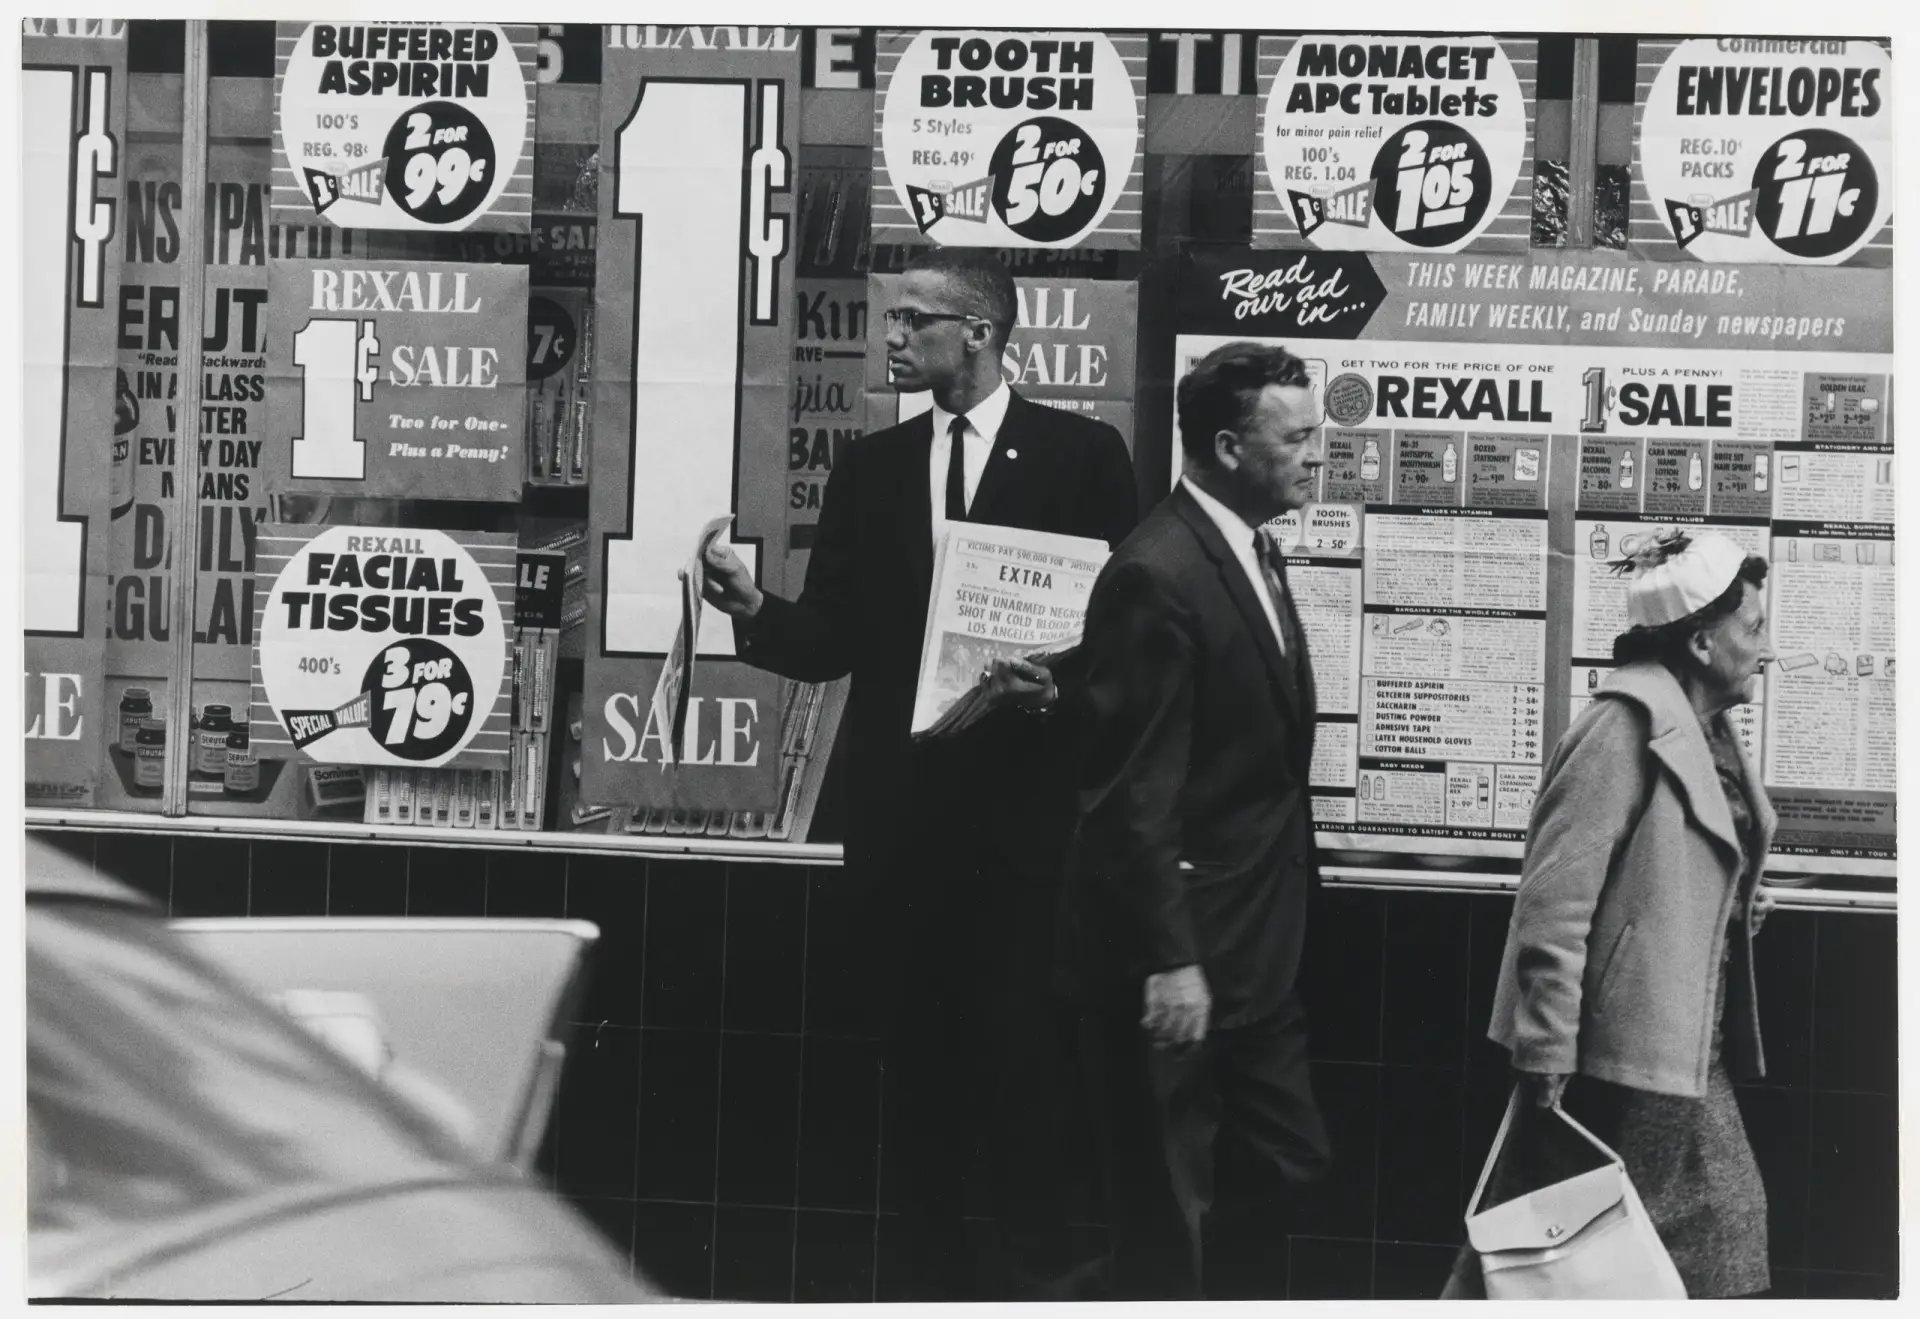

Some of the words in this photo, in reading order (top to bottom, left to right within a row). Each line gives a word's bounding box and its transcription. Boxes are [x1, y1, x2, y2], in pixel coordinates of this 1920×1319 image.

[312, 25, 498, 61] BUFFERED
[815, 29, 860, 87] E
[931, 38, 1094, 74] TOOTH
[1297, 44, 1497, 80] MONACET
[318, 61, 489, 98] ASPIRIN
[921, 75, 1094, 110] BRUSH
[1676, 65, 1882, 117] ENVELOPES
[1286, 83, 1362, 114] APC
[1368, 84, 1499, 117] Tablets
[405, 112, 432, 150] 2
[433, 126, 468, 145] FOR
[911, 119, 922, 133] 5
[927, 119, 972, 136] Styles
[1277, 126, 1291, 138] for
[1294, 127, 1325, 139] minor
[1328, 128, 1351, 141] pain
[1354, 126, 1383, 140] relief
[303, 143, 337, 157] REG.
[1012, 124, 1042, 165] 2
[1043, 138, 1081, 160] FOR
[1399, 130, 1429, 169] 2
[1429, 143, 1468, 163] FOR
[1773, 138, 1807, 181] 2
[1807, 153, 1851, 175] FOR
[341, 168, 381, 199] SALE
[1284, 166, 1318, 181] REG.
[1325, 166, 1357, 181] 1.04
[1681, 161, 1735, 178] PACKS
[946, 185, 987, 216] SALE
[1326, 189, 1369, 222] SALE
[1705, 199, 1750, 231] SALE
[309, 269, 481, 313] REXALL
[1219, 255, 1315, 300] Read
[1408, 262, 1456, 288] THIS
[1465, 263, 1523, 289] WEEK
[1234, 291, 1292, 320] our
[1296, 267, 1349, 303] ad
[1405, 302, 1481, 328] FAMILY
[1580, 307, 1621, 332] and
[1628, 307, 1708, 339] Sunday
[1717, 315, 1846, 341] newspapers
[390, 345, 499, 388] SALE
[1001, 342, 1108, 387] SALE
[1341, 360, 1364, 368] GET
[1370, 360, 1399, 369] TWO
[1404, 361, 1430, 370] FOR
[1435, 362, 1459, 370] THE
[1464, 363, 1501, 372] PRICE
[1506, 364, 1523, 372] OF
[1528, 365, 1554, 373] ONE
[1622, 367, 1656, 376] PLUS
[1661, 368, 1670, 376] A
[1674, 368, 1723, 377] PENNY!
[200, 374, 265, 403] LASS
[1376, 375, 1553, 423] REXALL
[1618, 382, 1733, 427] SALE
[389, 414, 424, 429] Two
[430, 415, 459, 430] for
[219, 441, 263, 468] DAY
[389, 442, 427, 457] Plus
[430, 447, 443, 458] a
[445, 443, 509, 463] Penny!
[134, 503, 267, 572] DILY
[1312, 519, 1351, 528] BRUSHES
[347, 535, 424, 554] REXALL
[967, 541, 996, 554] VICTIMS
[998, 546, 1013, 557] PAY
[1049, 558, 1064, 567] FOR
[306, 552, 464, 593] FACIAL
[999, 563, 1053, 591] EXTRA
[281, 592, 485, 637] TISSUES
[956, 588, 990, 606] SEVEN
[992, 596, 1047, 616] UNARMED
[957, 604, 986, 620] SHOT
[988, 610, 1002, 623] IN
[1006, 613, 1033, 628] COLD
[1036, 618, 1071, 630] BLOOD
[967, 621, 987, 635] LOS
[991, 626, 1036, 641] ANGELES
[298, 656, 341, 675] 400's
[382, 646, 411, 689] 3
[412, 658, 453, 684] FOR
[1376, 691, 1411, 700] GLYCERIN
[1413, 694, 1471, 702] SUPPOSITORIES
[1377, 680, 1412, 689] BUFFERED
[1415, 682, 1445, 690] ASPIRIN
[290, 711, 332, 741] SPECIAL
[336, 700, 369, 726] VALUE
[1376, 702, 1417, 711] SACCHARIN
[1376, 713, 1407, 721] DUSTING
[1410, 714, 1441, 723] POWDER
[602, 692, 759, 766] SALE
[1375, 723, 1410, 733] ADHESIVE
[1413, 725, 1431, 733] TAPE
[1375, 735, 1396, 743] LATEX
[1399, 736, 1442, 745] HOUSEHOLD
[1444, 738, 1472, 746] GLOVES
[1374, 745, 1402, 754] COTTON
[1404, 747, 1426, 755] BALLS
